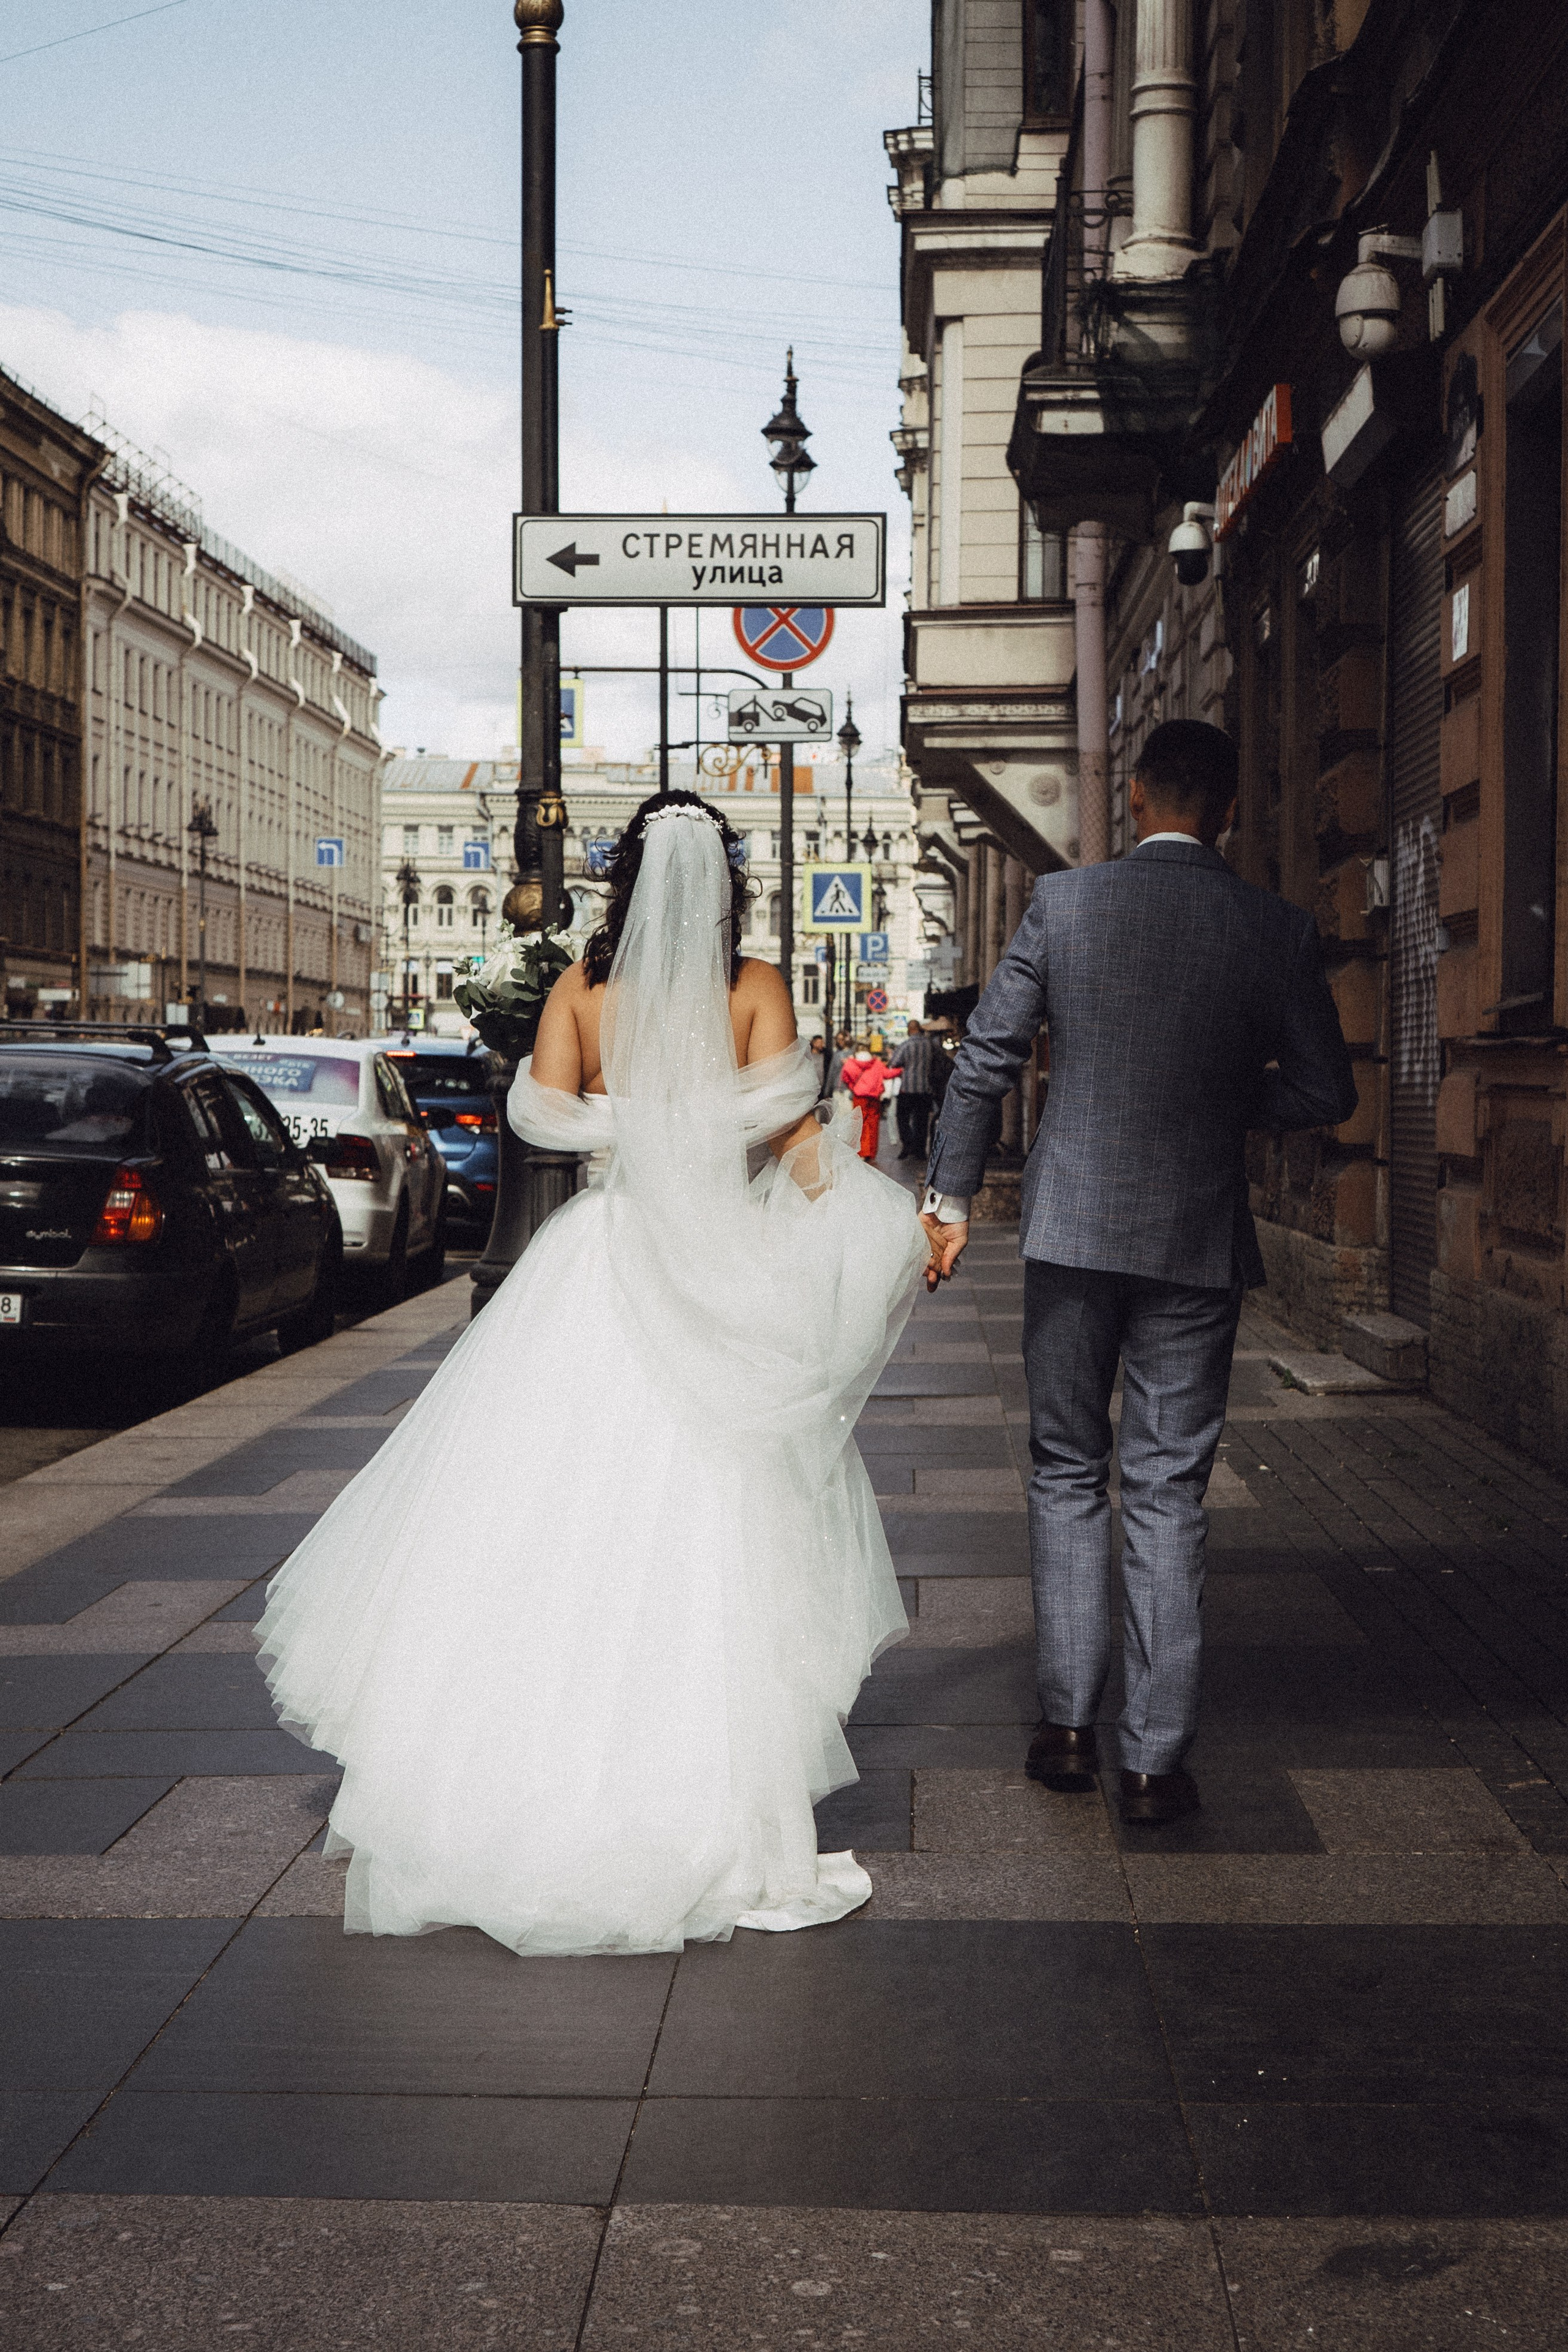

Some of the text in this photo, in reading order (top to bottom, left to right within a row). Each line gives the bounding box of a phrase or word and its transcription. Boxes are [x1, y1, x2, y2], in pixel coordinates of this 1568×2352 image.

[622, 532, 854, 559] СТРЕМЯННАЯ
[692, 565, 783, 590] улица
[867, 935, 884, 960] P
